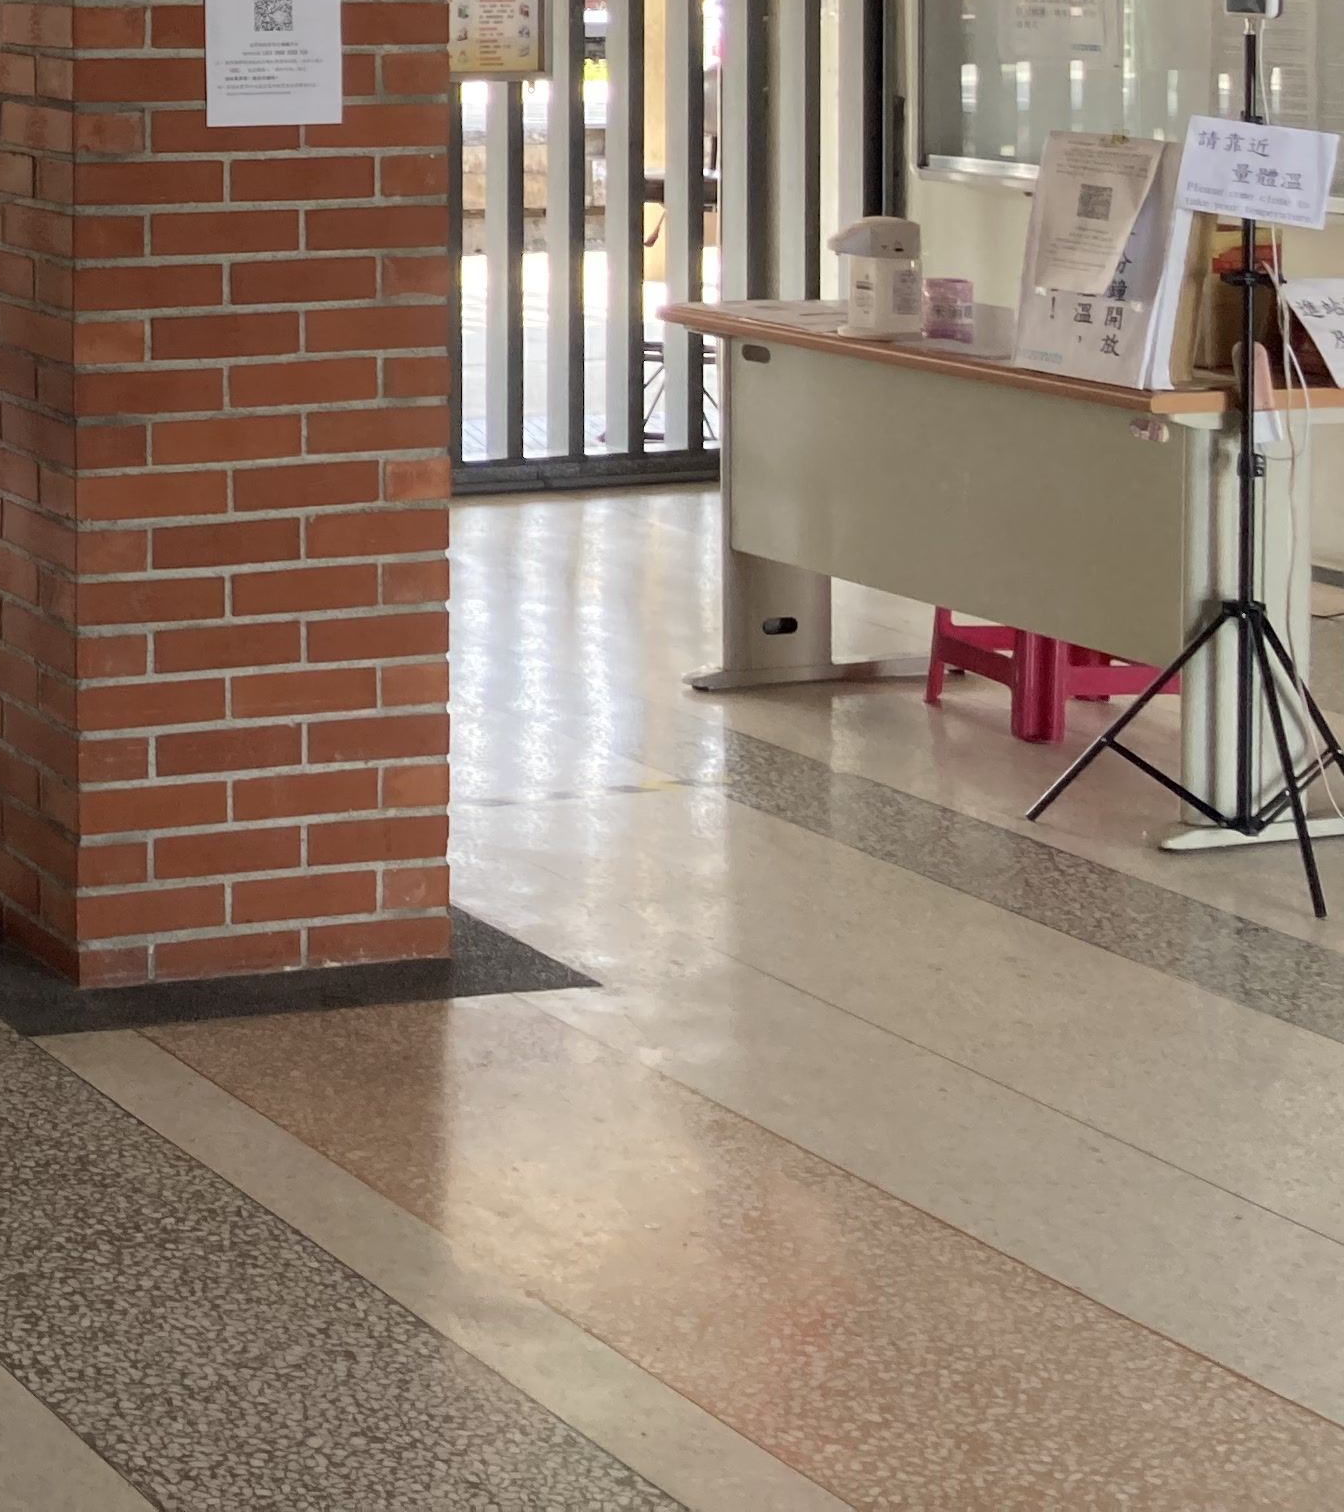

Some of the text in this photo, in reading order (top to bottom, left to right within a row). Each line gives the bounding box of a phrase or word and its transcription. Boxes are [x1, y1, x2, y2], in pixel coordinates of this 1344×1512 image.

[1198, 131, 1270, 157] 請靠近
[1233, 164, 1304, 191] 量體溫
